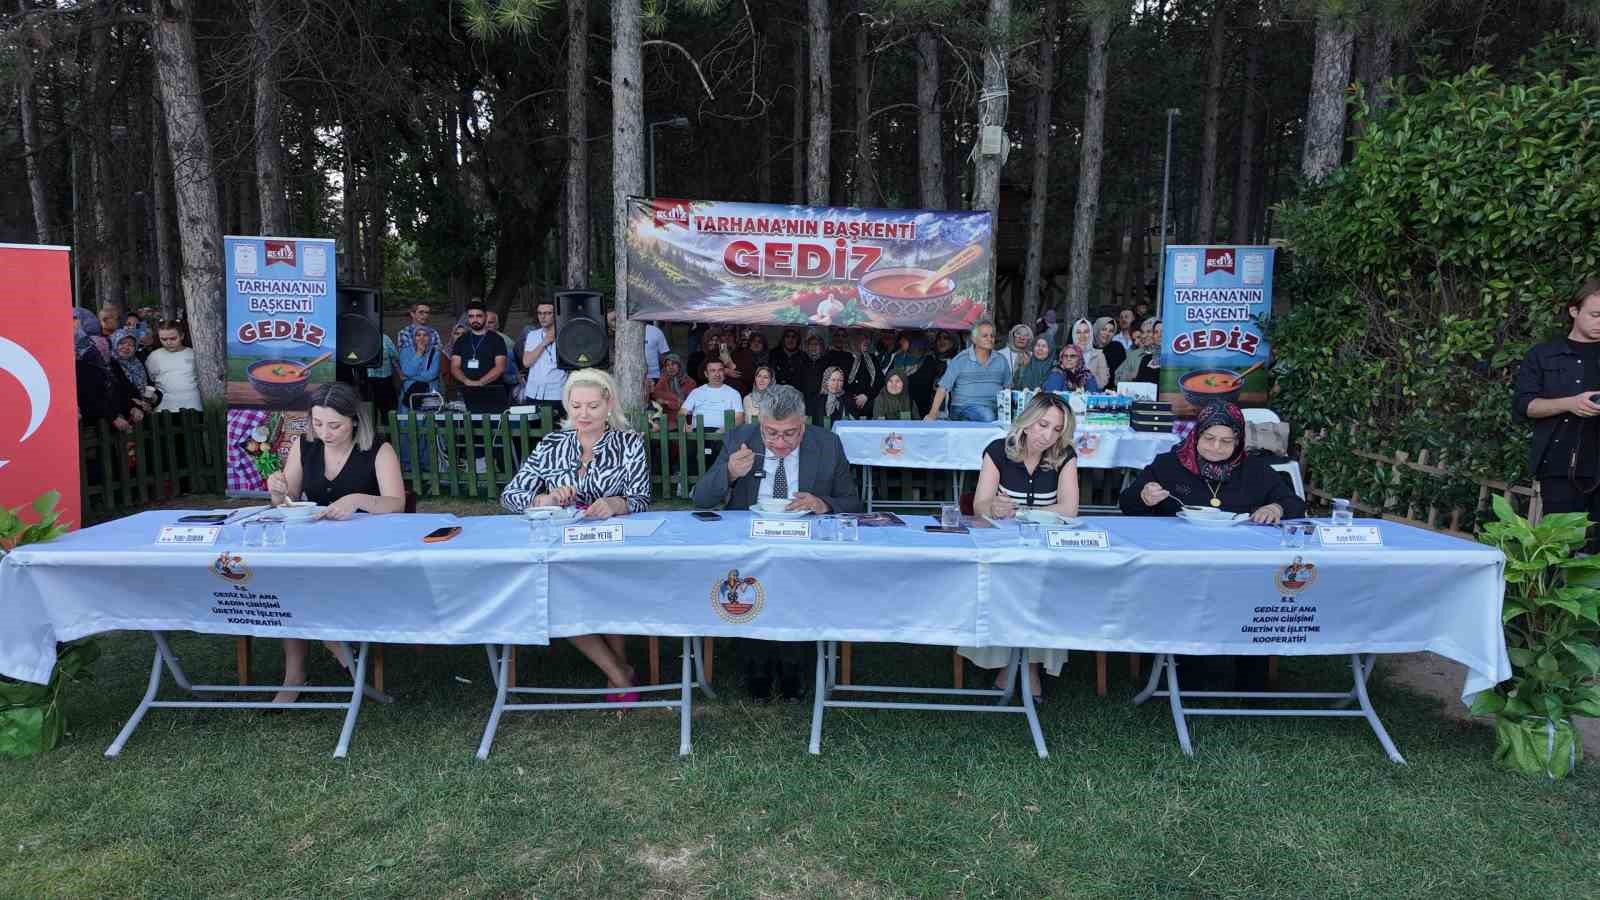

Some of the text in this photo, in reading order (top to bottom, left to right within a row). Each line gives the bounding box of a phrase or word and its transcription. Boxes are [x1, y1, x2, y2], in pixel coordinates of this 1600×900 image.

[694, 215, 917, 242] TARHANA'NIN BAŞKENTİ
[722, 238, 884, 281] GEDİZ
[237, 280, 326, 294] TARHANA'NIN
[1175, 289, 1263, 303] TARHANA'NIN
[250, 296, 313, 315] BAŞKENTİ
[1186, 305, 1249, 323] BAŞKENTİ
[239, 317, 326, 346] GEDİZ
[1172, 326, 1260, 356] GEDİZ
[1254, 605, 1279, 613] GEDİZ
